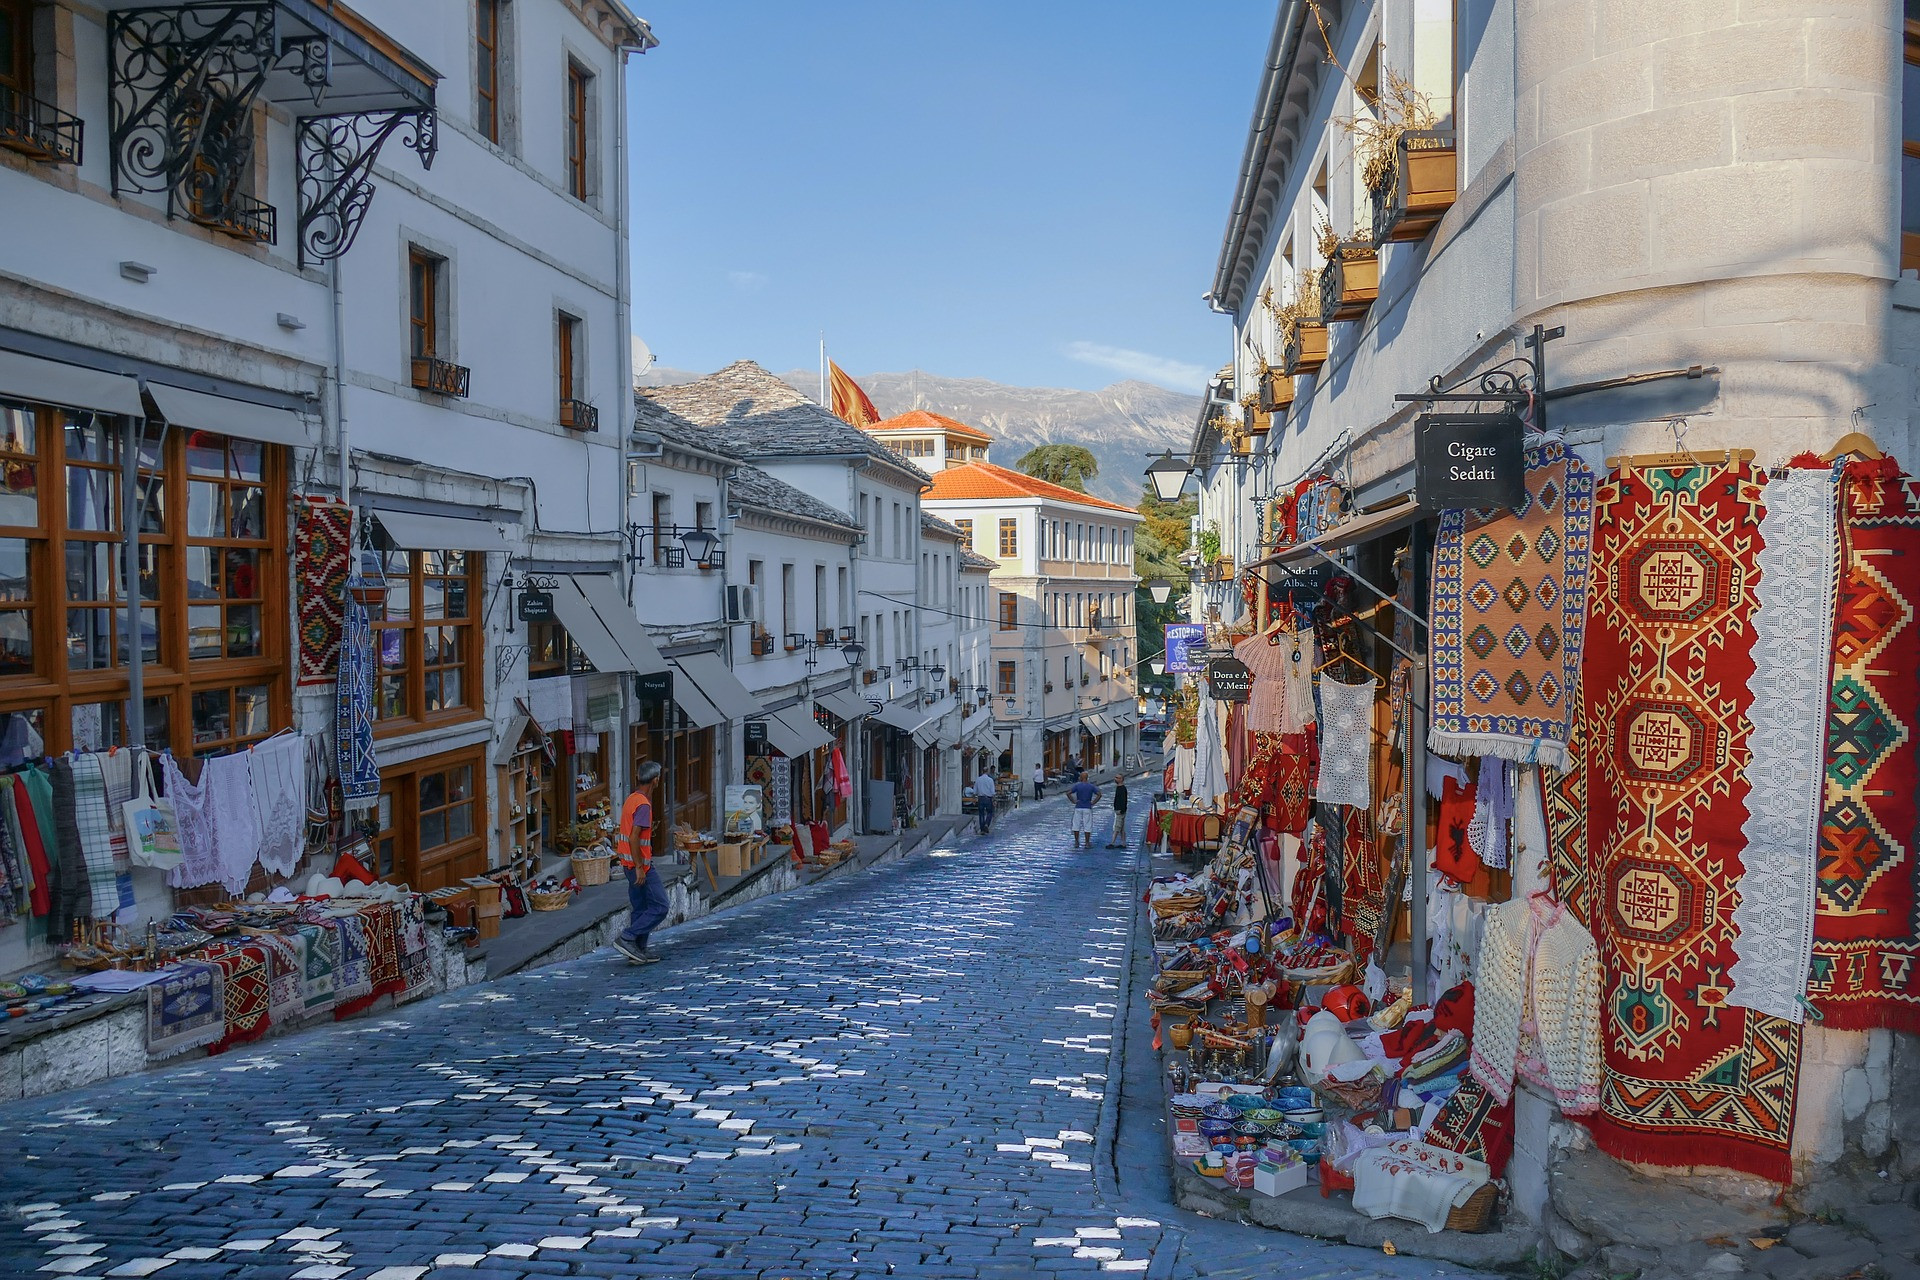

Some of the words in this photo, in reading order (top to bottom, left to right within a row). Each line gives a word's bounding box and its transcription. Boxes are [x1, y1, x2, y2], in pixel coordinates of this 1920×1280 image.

[1447, 441, 1497, 462] Cigare
[1449, 465, 1496, 481] Sedati
[1309, 566, 1318, 575] In
[1284, 579, 1318, 587] Albaia
[1213, 671, 1233, 679] Dora
